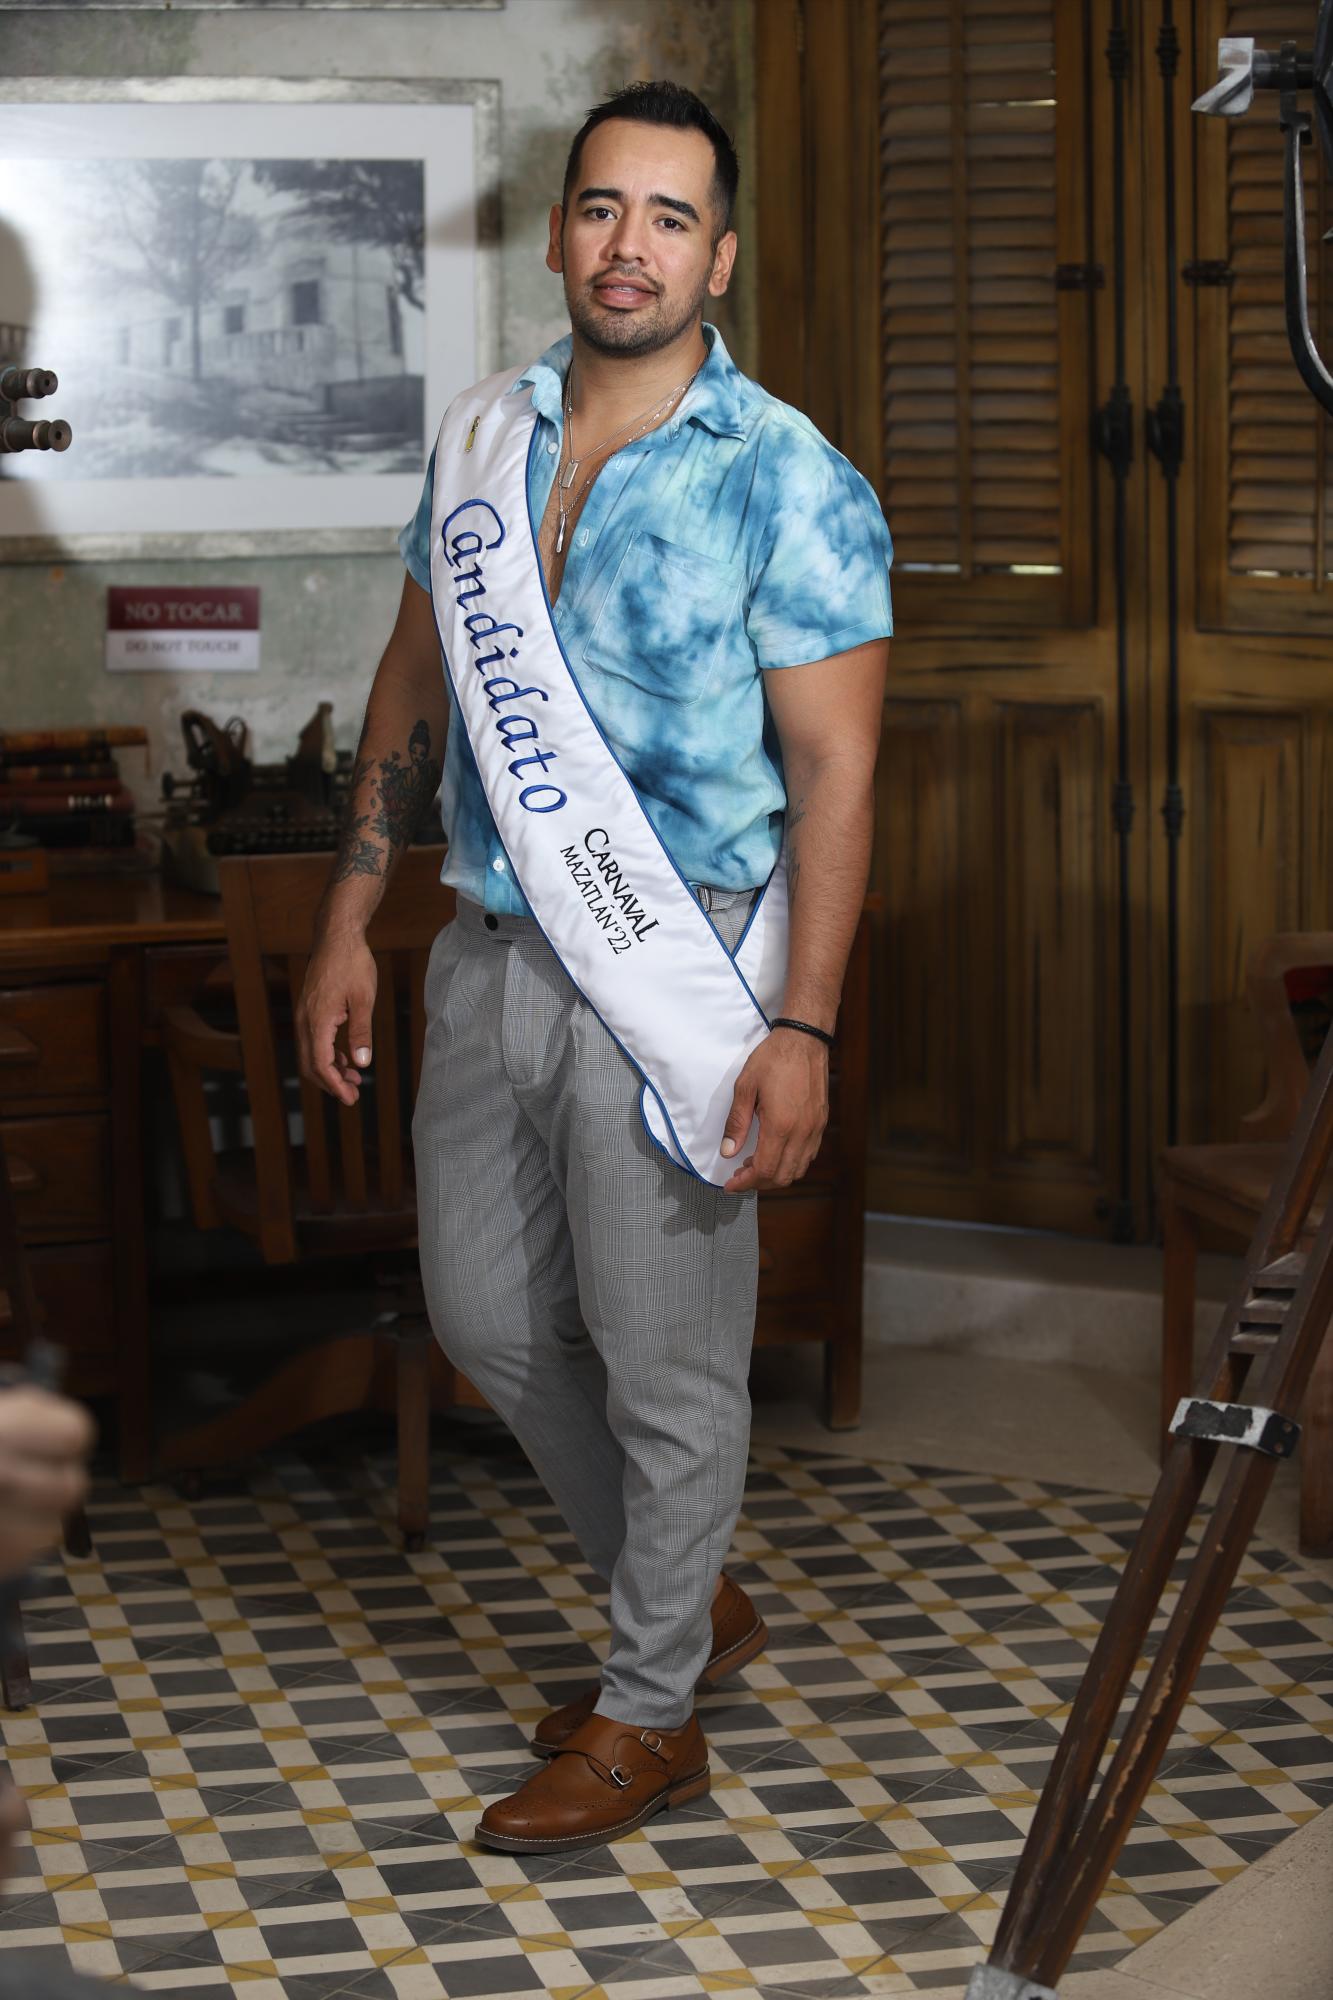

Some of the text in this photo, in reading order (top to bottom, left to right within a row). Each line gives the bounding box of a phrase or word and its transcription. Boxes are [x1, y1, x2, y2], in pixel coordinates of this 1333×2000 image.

[125, 602, 243, 623] NO TOCAR
[125, 640, 240, 653] DO NOT TOUCH
[441, 498, 568, 813] Candidato
[584, 828, 660, 943] CARNAVAL
